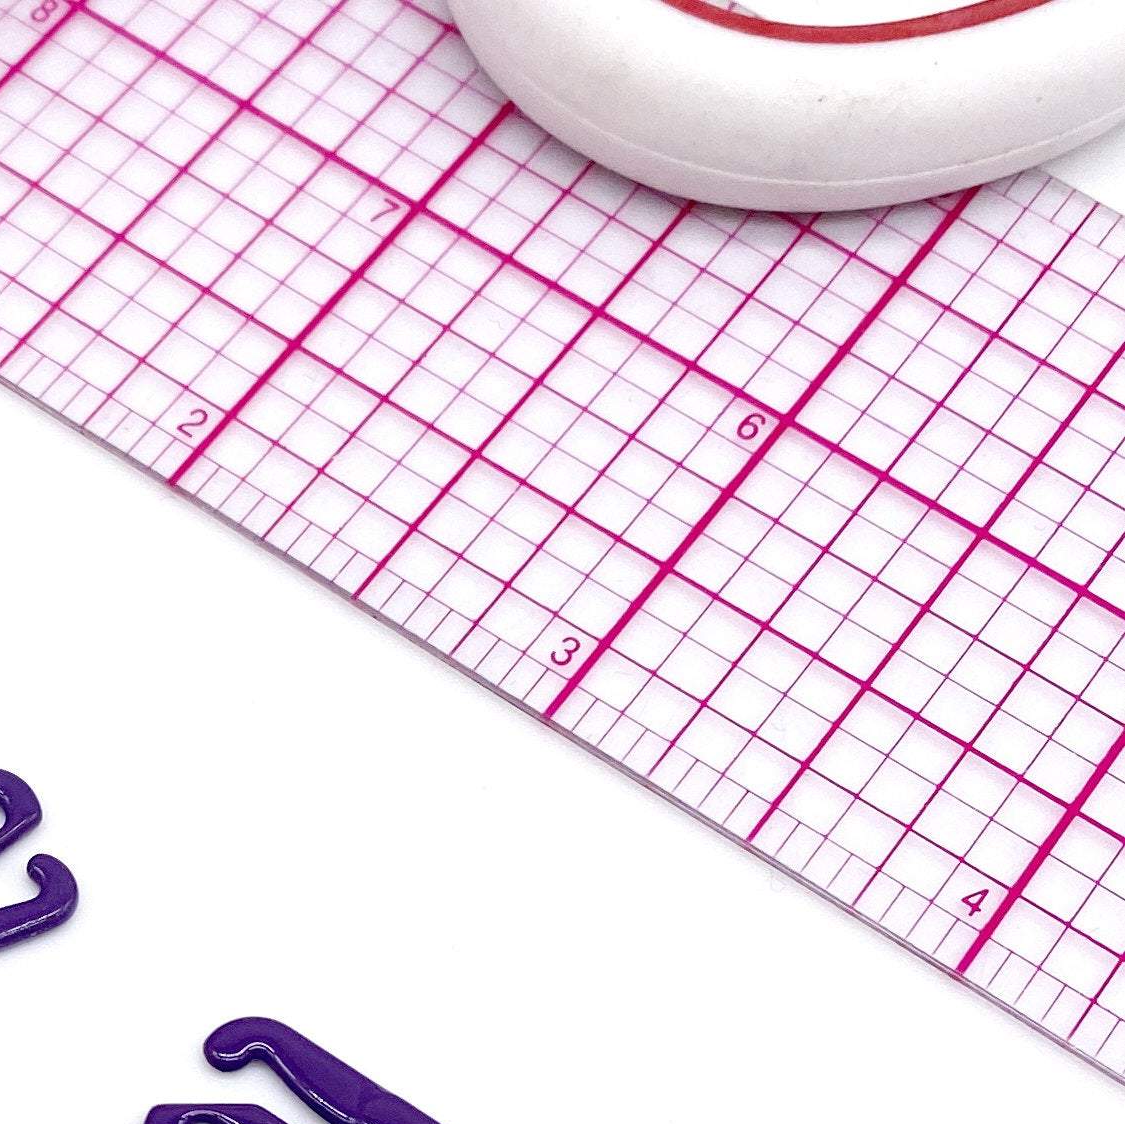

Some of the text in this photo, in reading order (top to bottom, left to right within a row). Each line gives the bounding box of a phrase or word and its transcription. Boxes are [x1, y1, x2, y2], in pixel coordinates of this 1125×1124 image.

[31, 0, 59, 23] 8
[370, 198, 401, 223] 7
[176, 408, 209, 439] 2
[736, 412, 767, 441] 6
[550, 636, 581, 666] 3
[960, 888, 990, 917] 4
